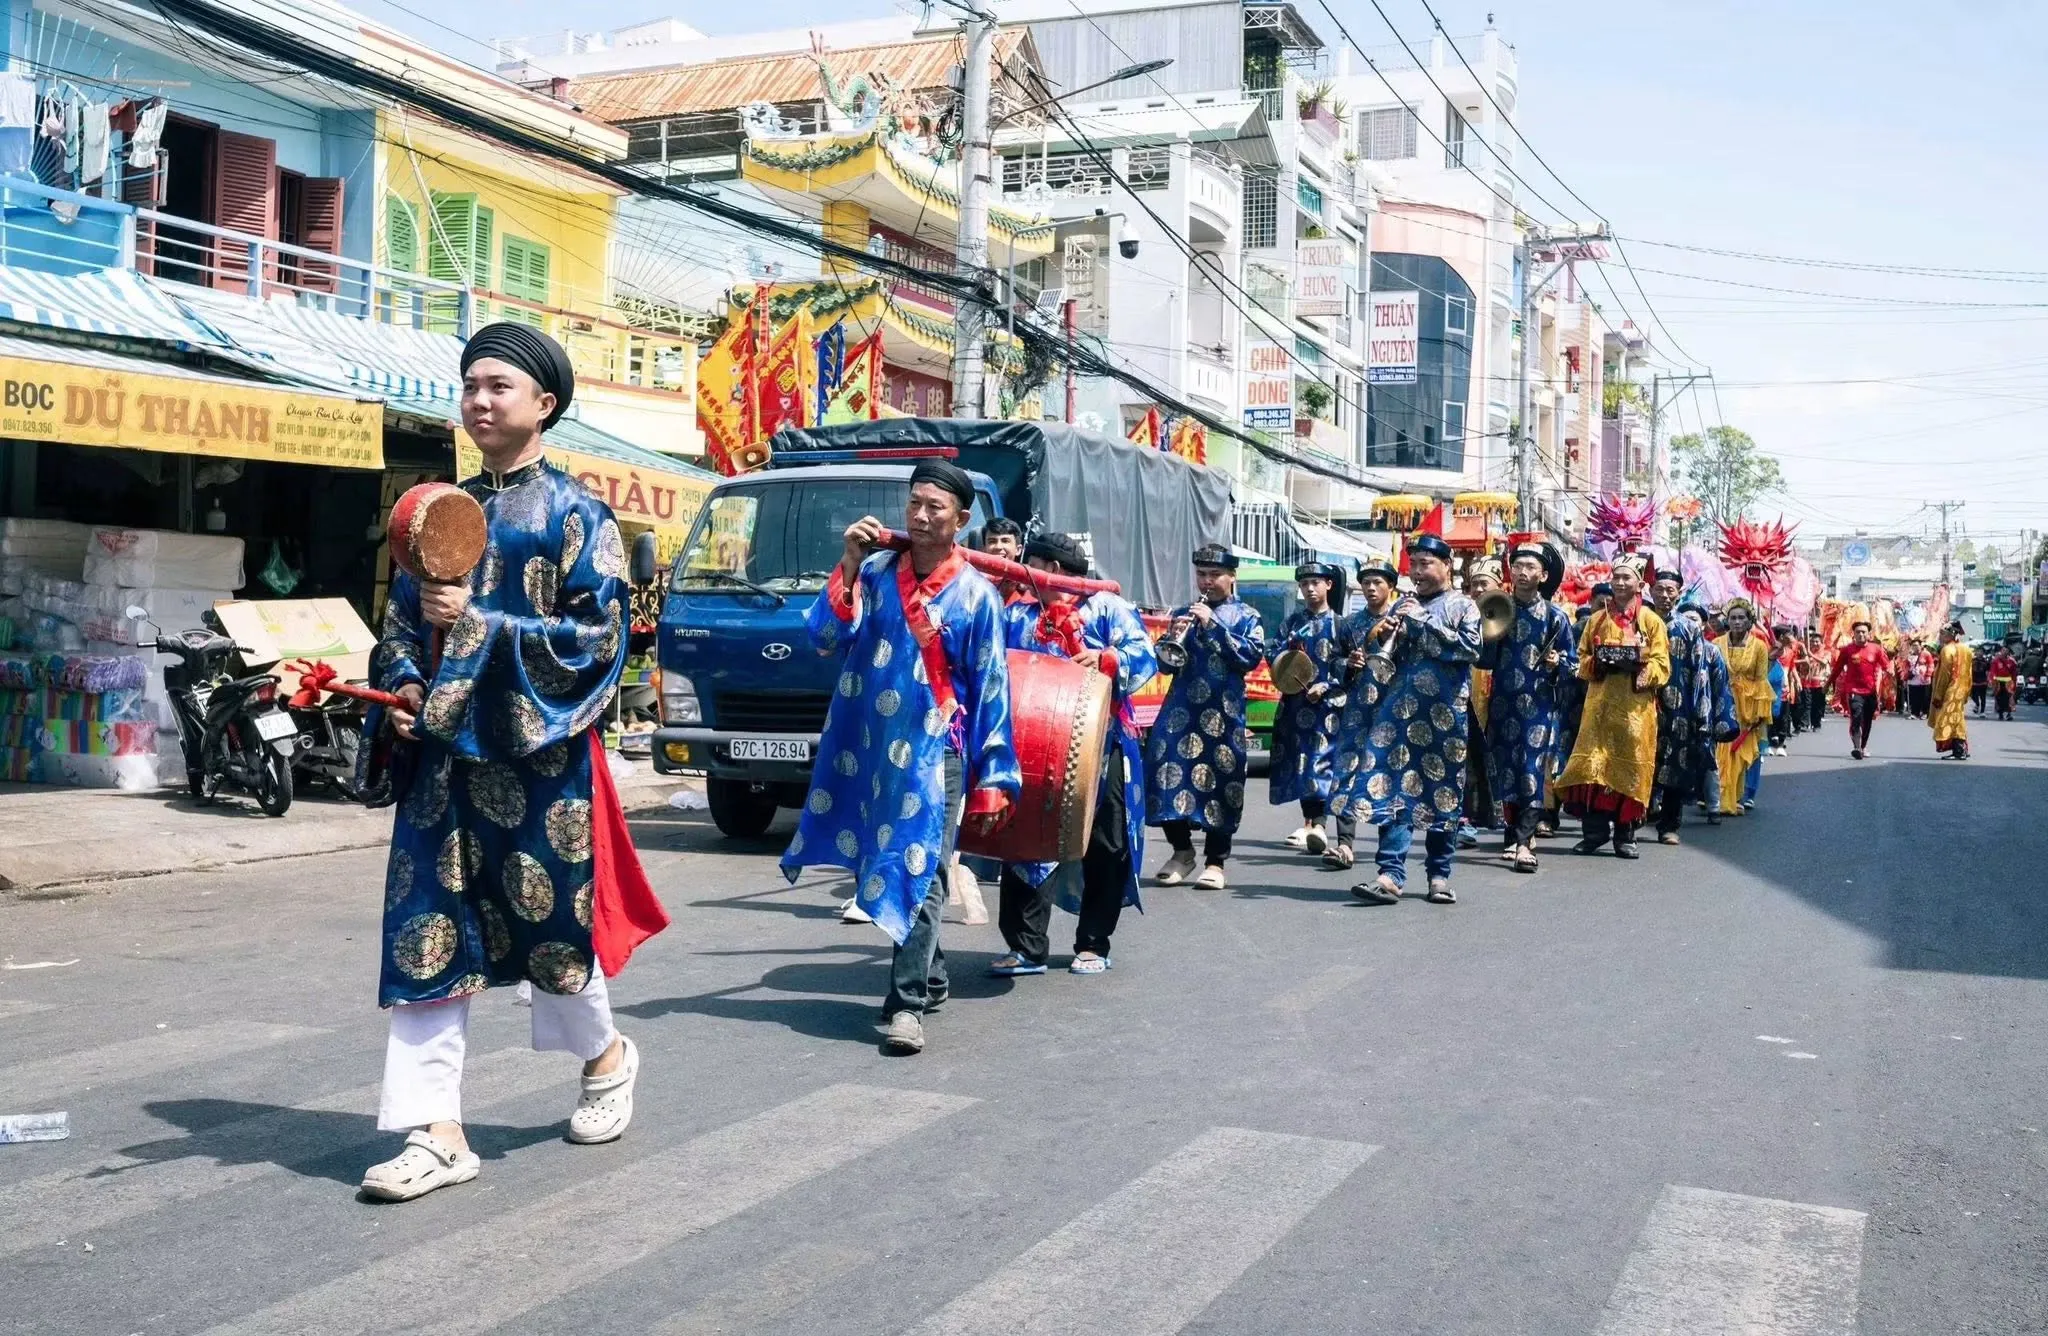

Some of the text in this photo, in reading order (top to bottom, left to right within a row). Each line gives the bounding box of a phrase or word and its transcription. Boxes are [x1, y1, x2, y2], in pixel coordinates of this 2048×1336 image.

[1302, 246, 1343, 265] TRUNG
[4, 379, 54, 415] BỌC
[137, 392, 272, 448] THẠNH
[674, 628, 710, 638] HYUNDAI
